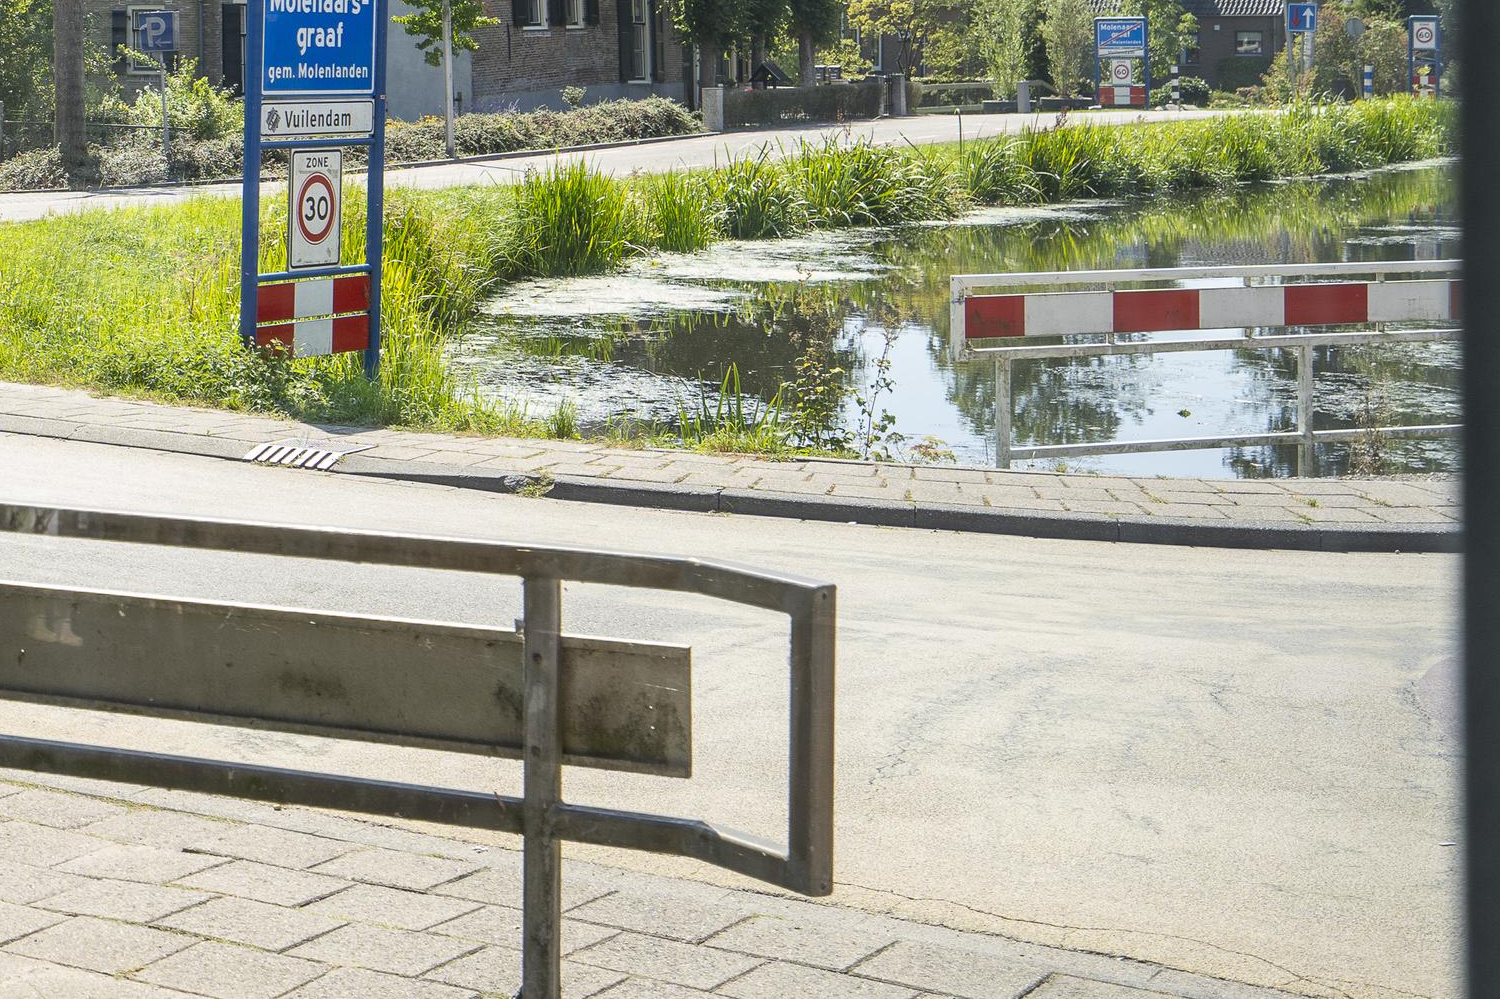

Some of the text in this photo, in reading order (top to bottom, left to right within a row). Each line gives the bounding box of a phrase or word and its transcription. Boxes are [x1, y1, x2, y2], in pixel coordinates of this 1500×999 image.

[296, 21, 344, 56] graaf
[268, 62, 369, 83] gem. Molenlanden
[284, 109, 352, 128] Vuilendam
[306, 157, 329, 168] ZONE
[304, 196, 329, 221] 30
